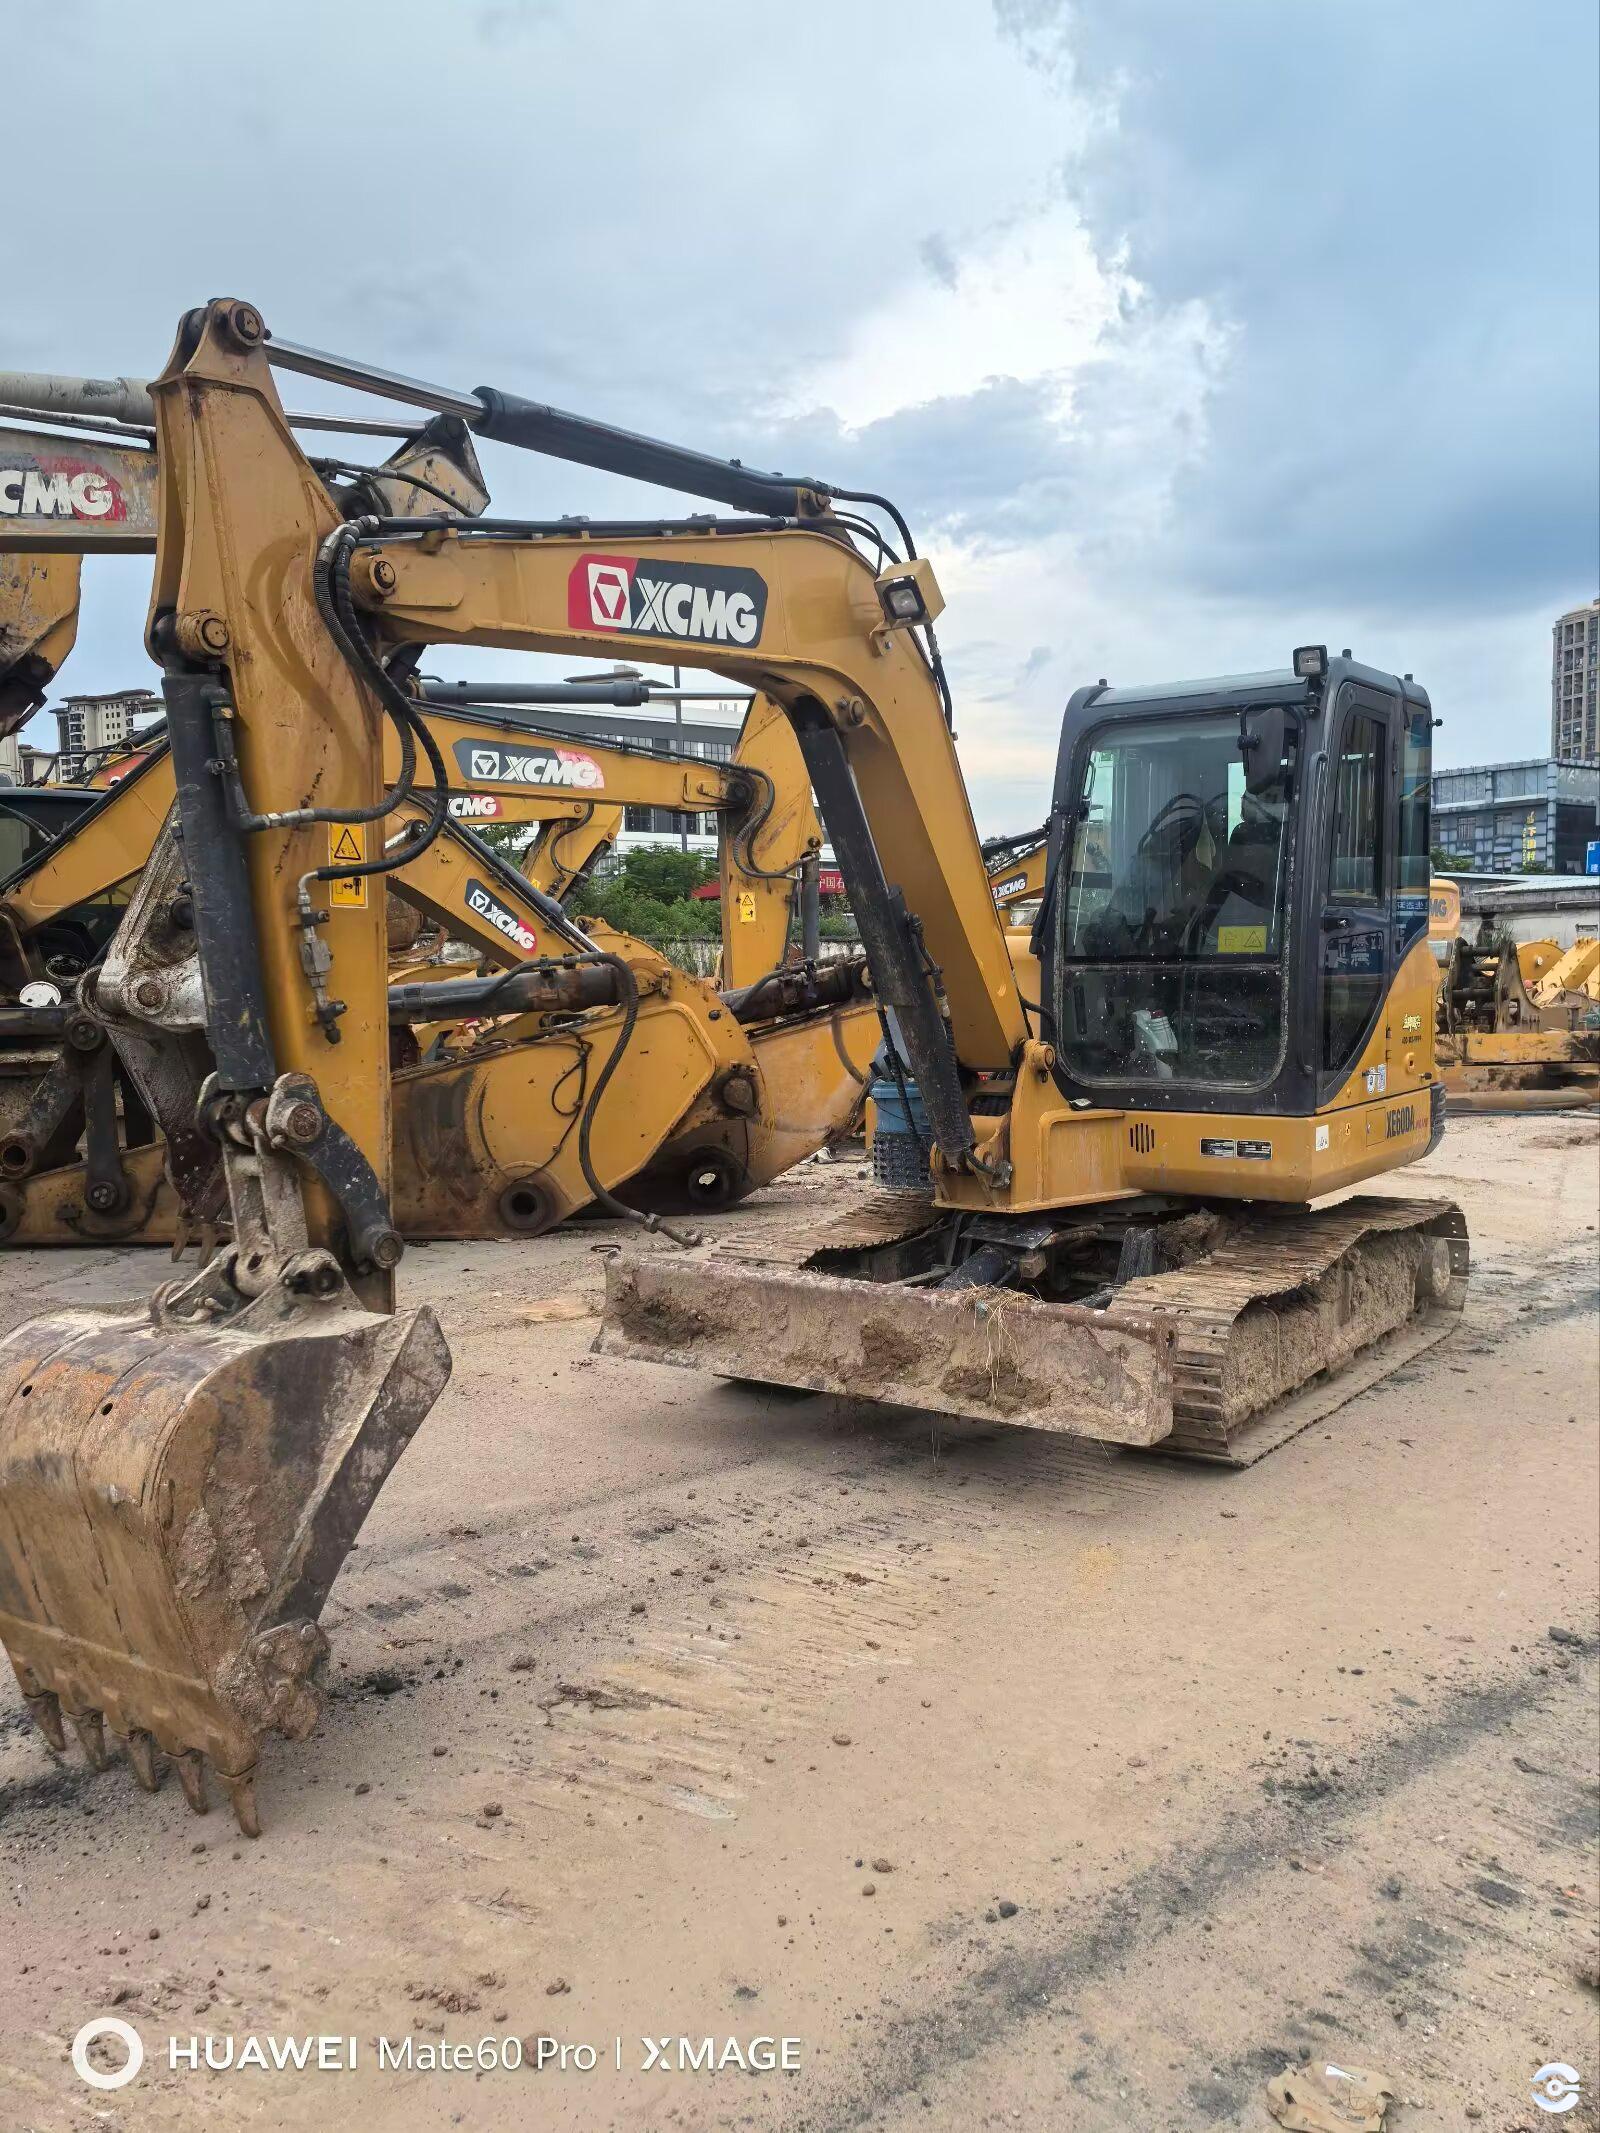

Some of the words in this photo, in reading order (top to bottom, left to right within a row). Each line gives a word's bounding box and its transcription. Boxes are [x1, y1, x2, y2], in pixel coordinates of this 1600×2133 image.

[631, 578, 757, 643] XCMG
[499, 756, 597, 787] XCMG
[447, 796, 497, 817] CMG
[998, 878, 1026, 897] XCMG
[482, 903, 536, 950] XCMG
